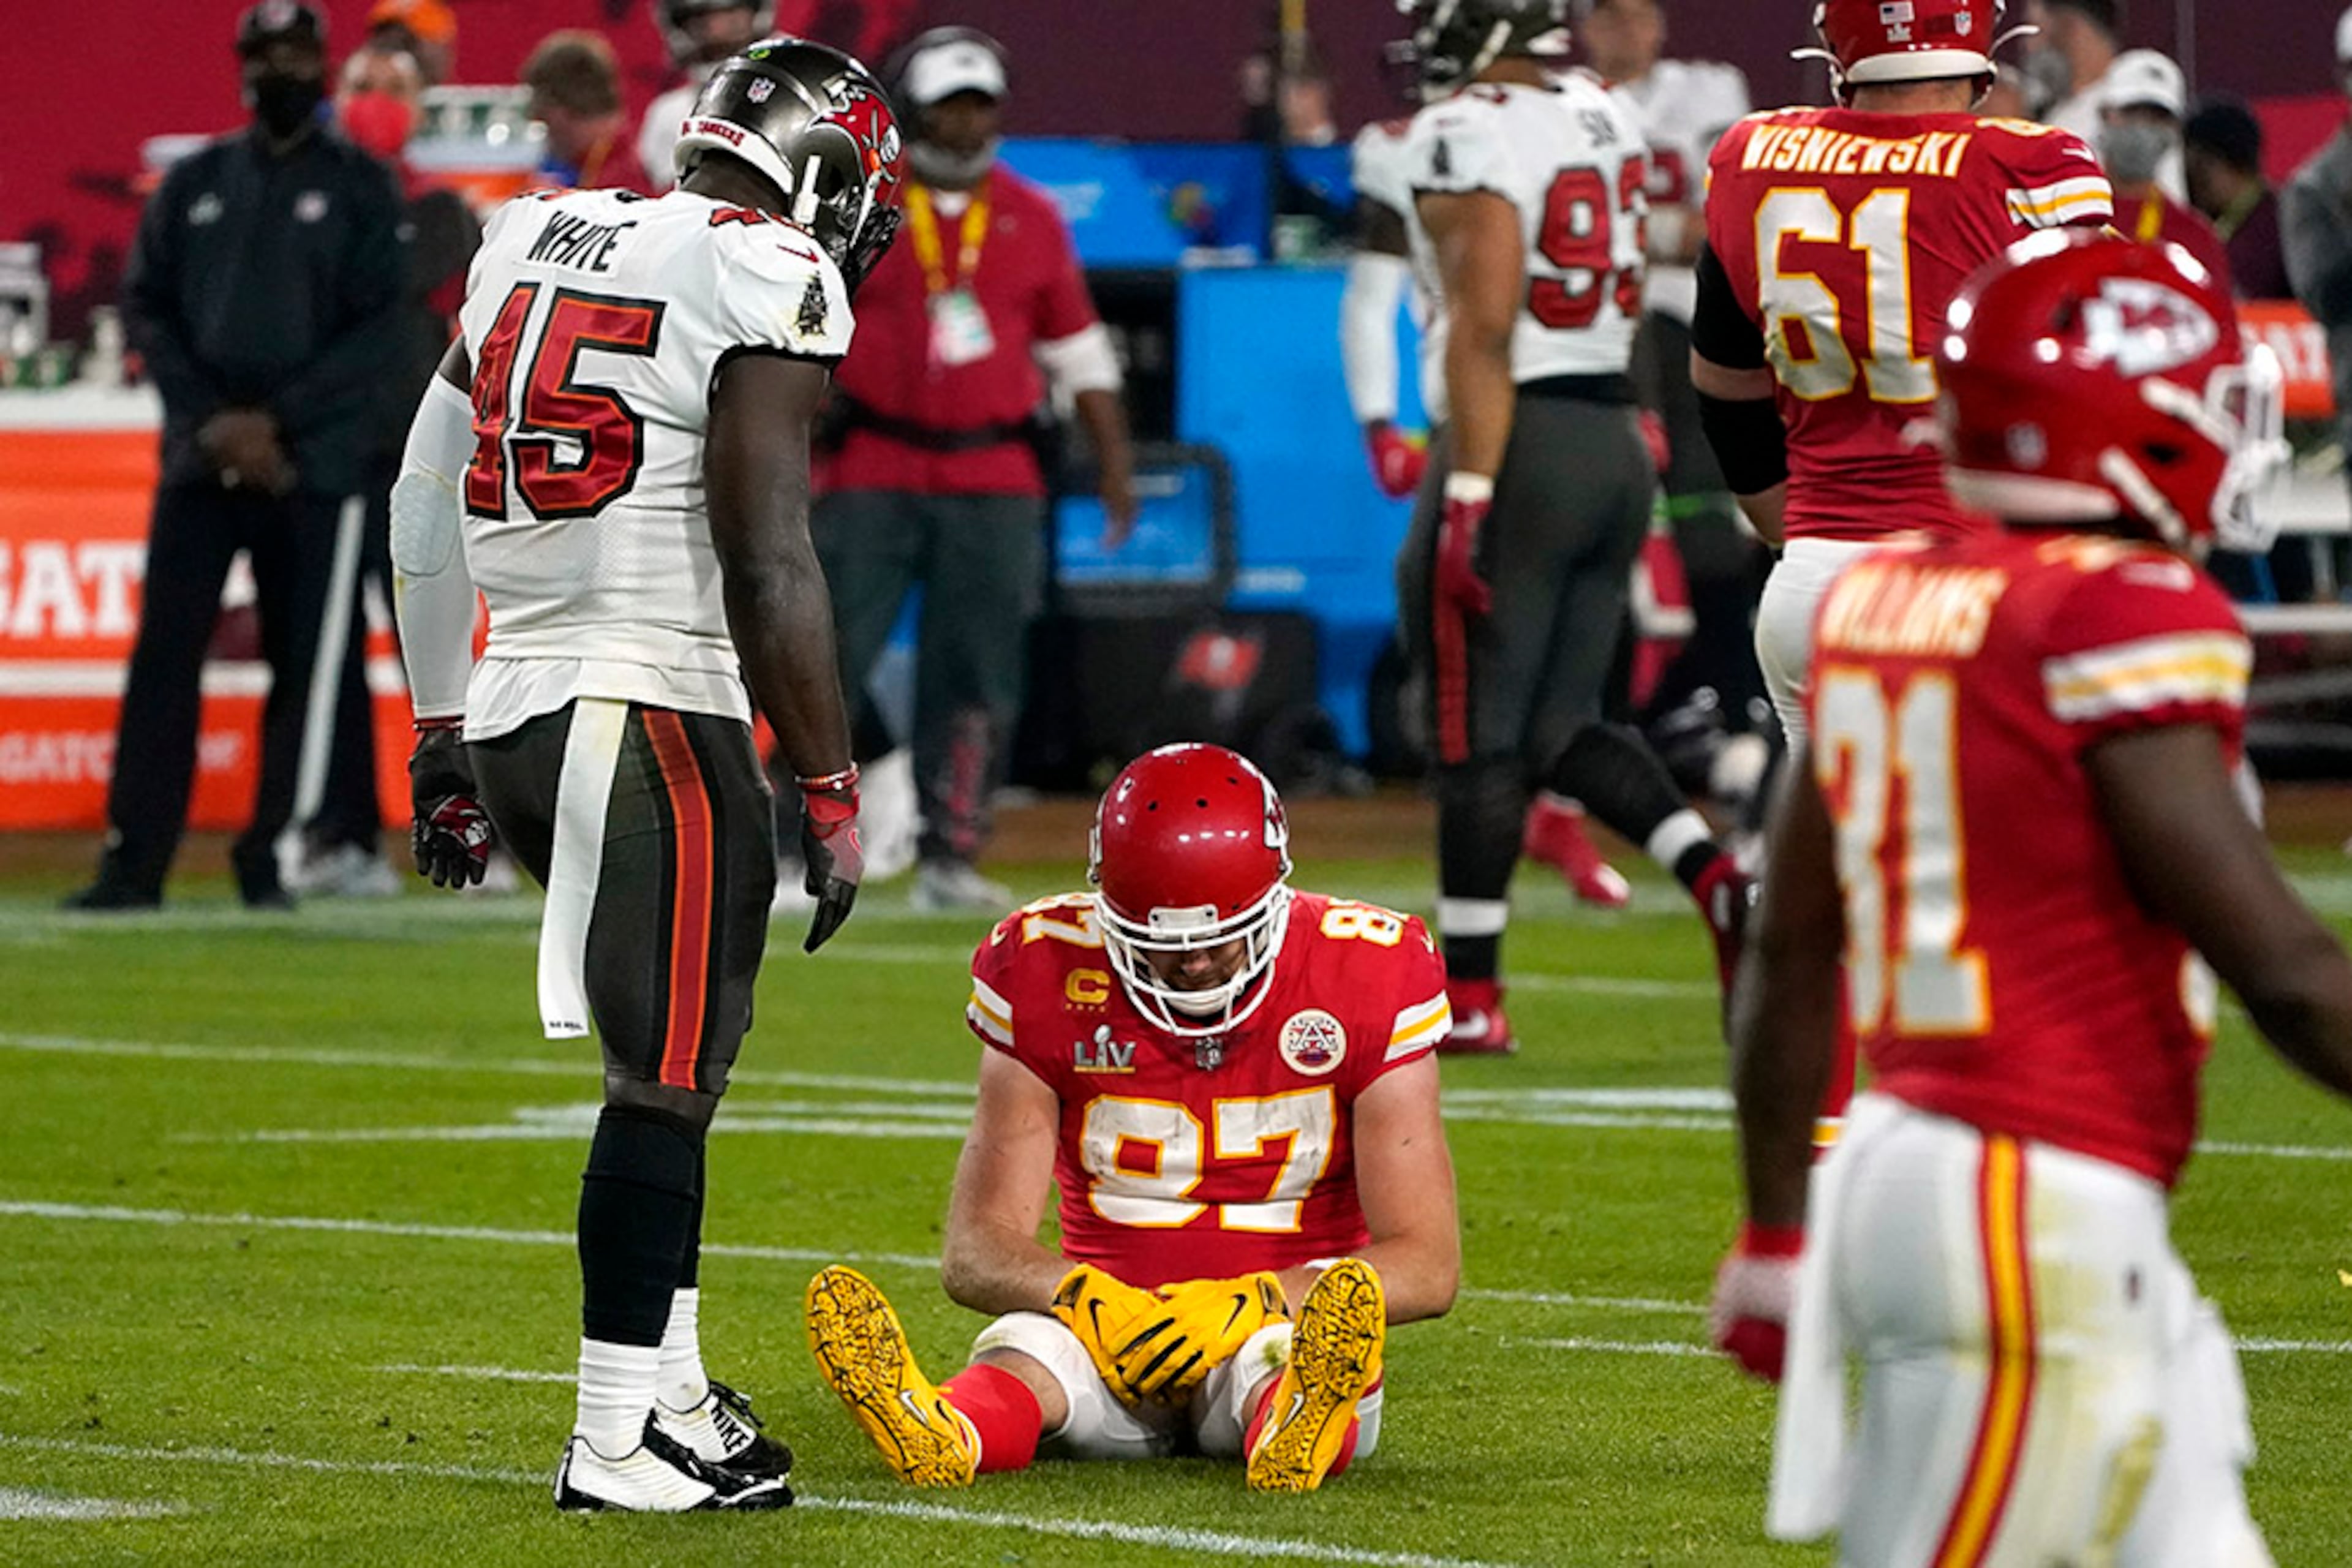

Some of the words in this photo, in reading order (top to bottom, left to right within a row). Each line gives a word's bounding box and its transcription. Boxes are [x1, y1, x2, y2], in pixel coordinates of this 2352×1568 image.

[1742, 124, 1972, 178] WISNIEWSKI
[526, 211, 638, 273] WHITE
[1754, 187, 1940, 404] 61
[1065, 968, 1110, 1005] C
[1074, 1025, 1137, 1068] LIV
[1080, 1084, 1338, 1234] 87
[711, 1403, 751, 1454] NIKE
